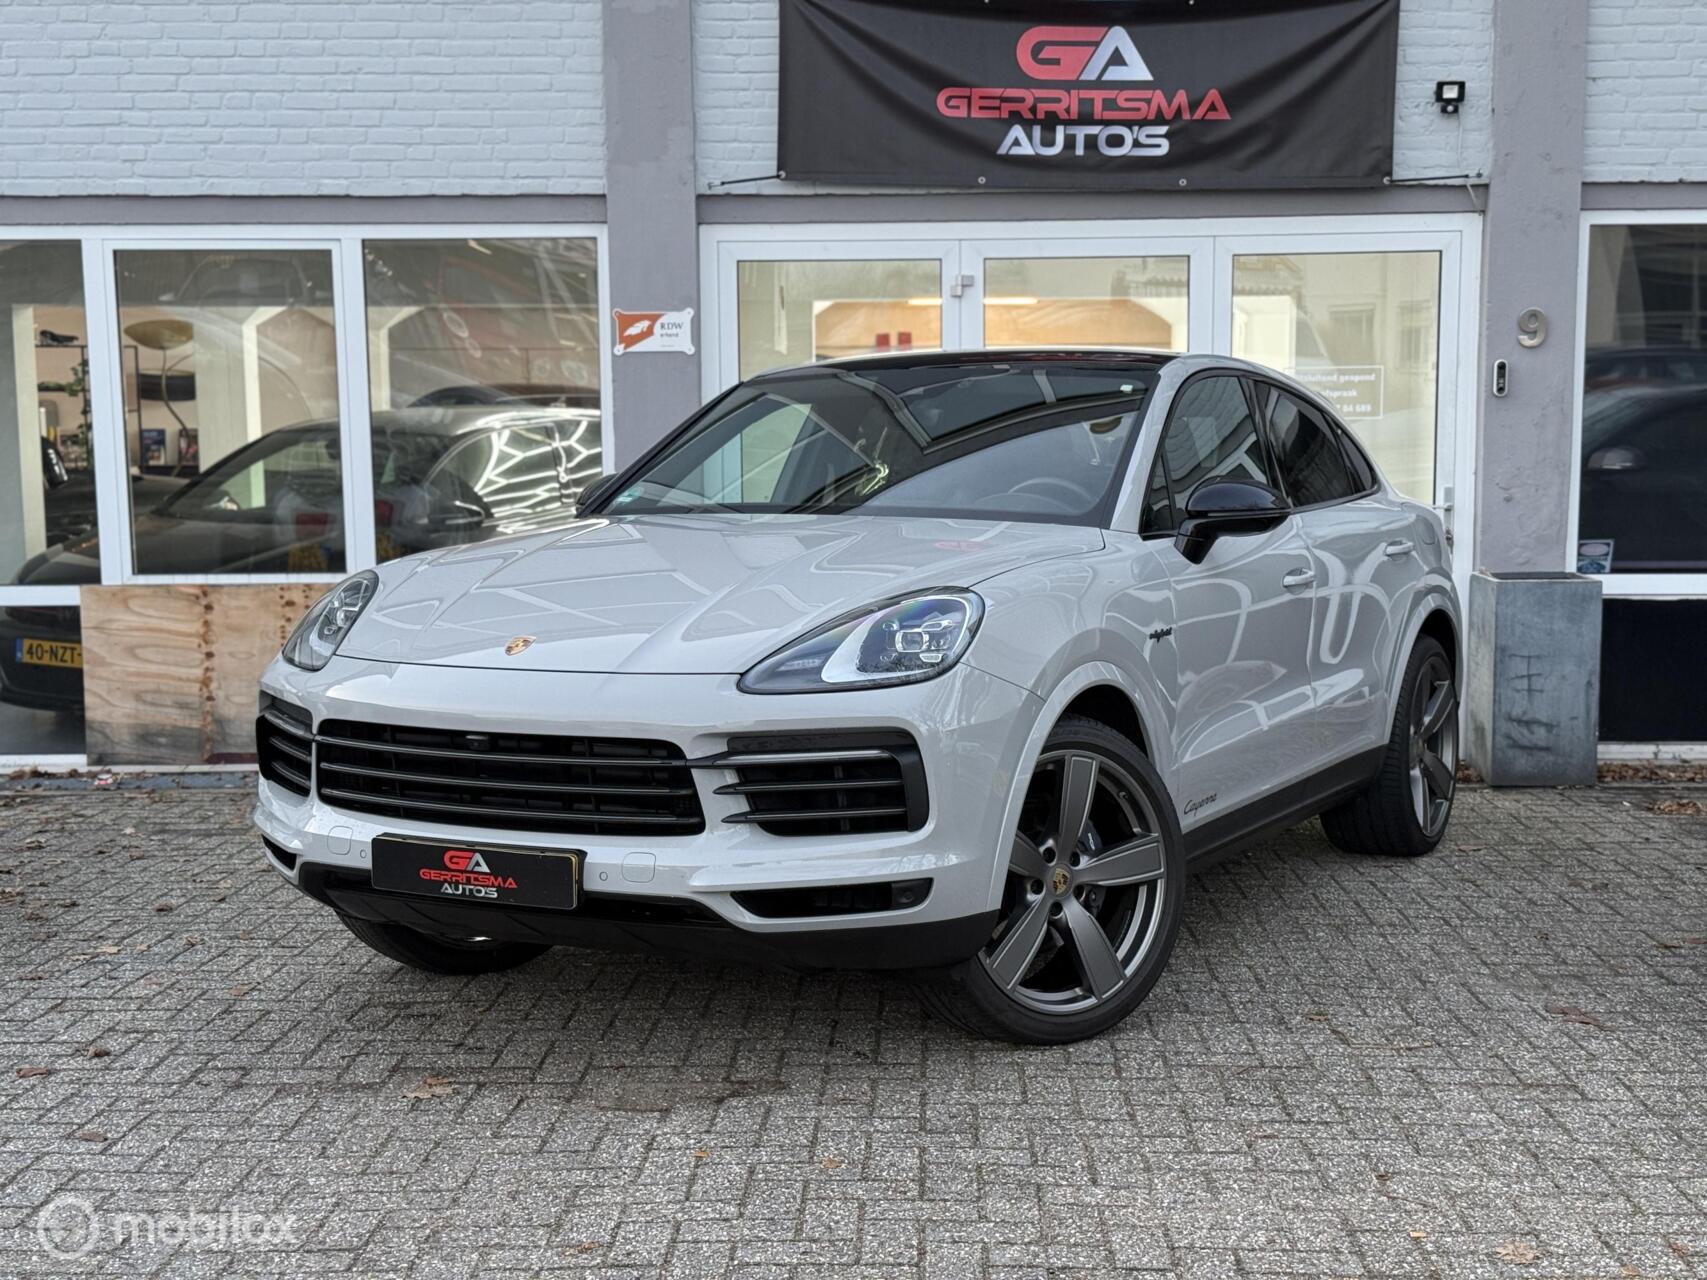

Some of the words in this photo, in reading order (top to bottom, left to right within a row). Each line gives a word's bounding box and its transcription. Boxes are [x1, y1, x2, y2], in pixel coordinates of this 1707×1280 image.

[1016, 25, 1154, 81] GA
[936, 87, 1232, 120] GERRITSMA
[996, 124, 1170, 157] AUTO'S
[660, 321, 684, 331] RDW
[1517, 306, 1547, 349] 9
[444, 849, 491, 873] GA
[419, 868, 518, 889] GERRITSMA
[440, 884, 499, 899] AUTO'S
